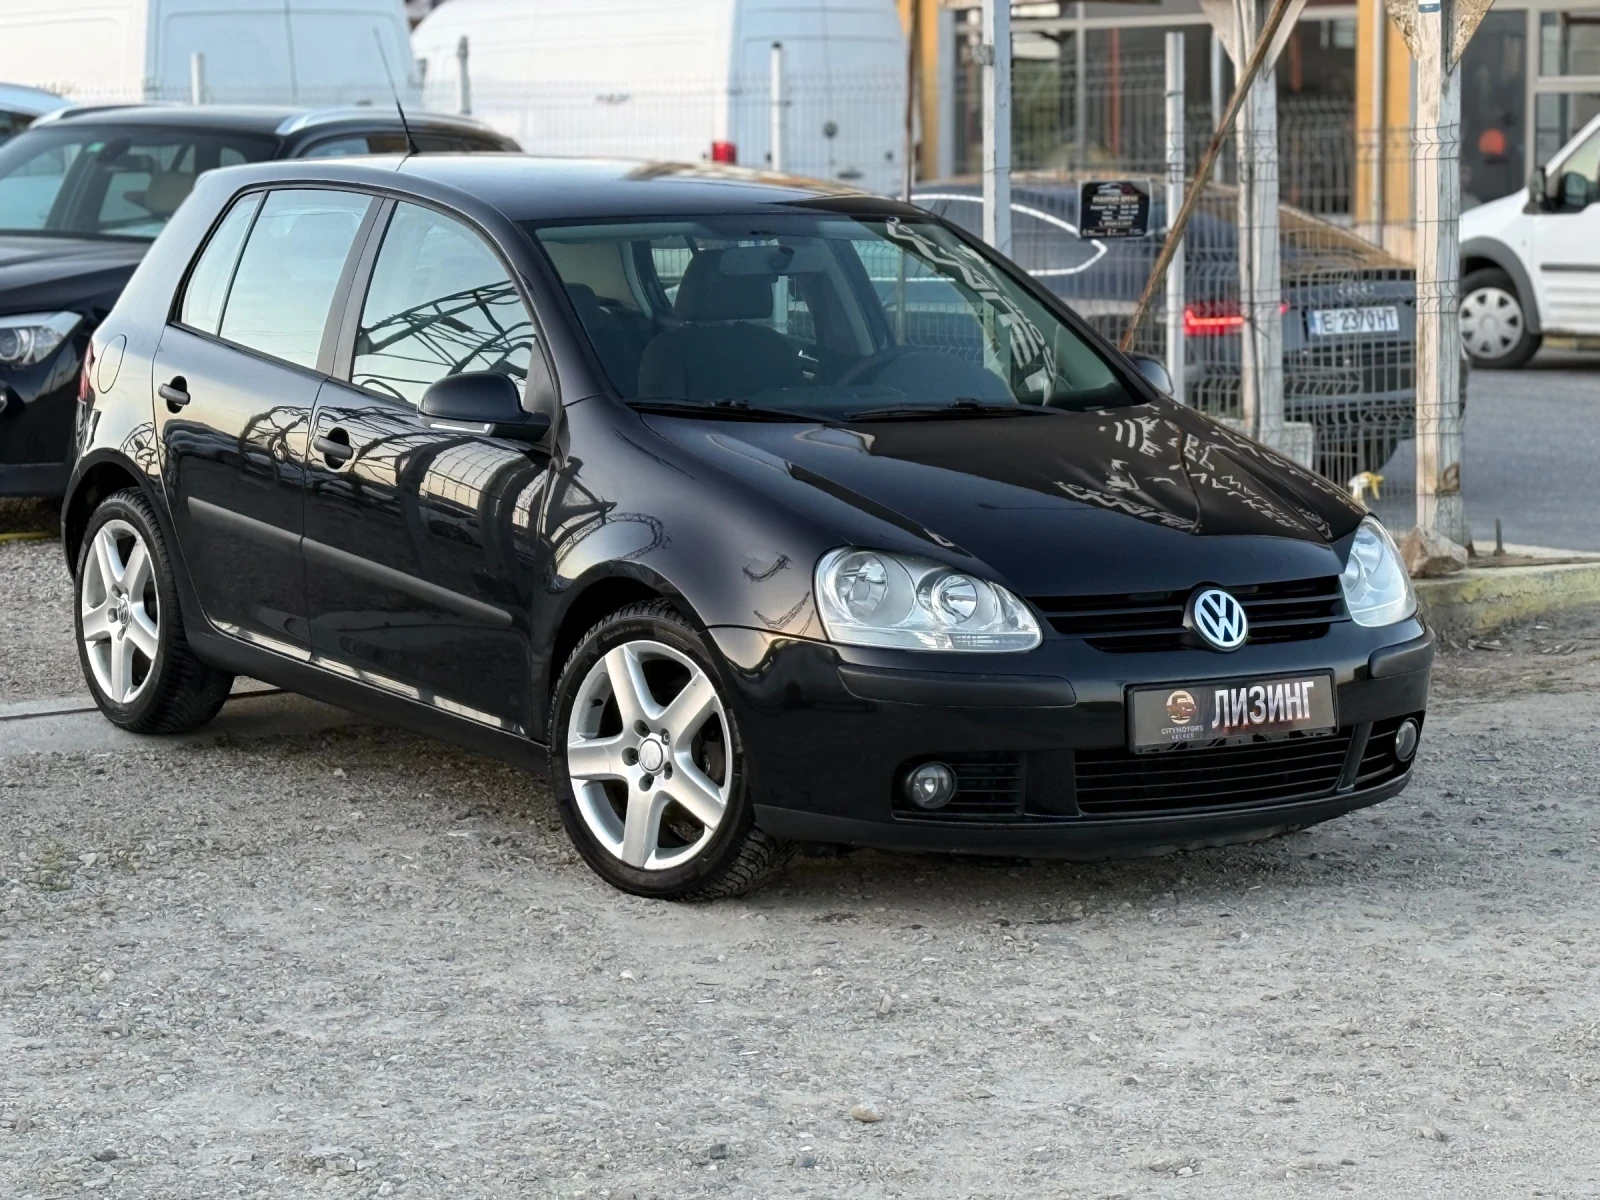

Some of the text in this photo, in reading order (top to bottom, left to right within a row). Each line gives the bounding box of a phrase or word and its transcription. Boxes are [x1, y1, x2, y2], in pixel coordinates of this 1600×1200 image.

[1322, 313, 1332, 332] E
[1195, 590, 1247, 647] VW
[1211, 680, 1315, 730] ЛИЗИНГ
